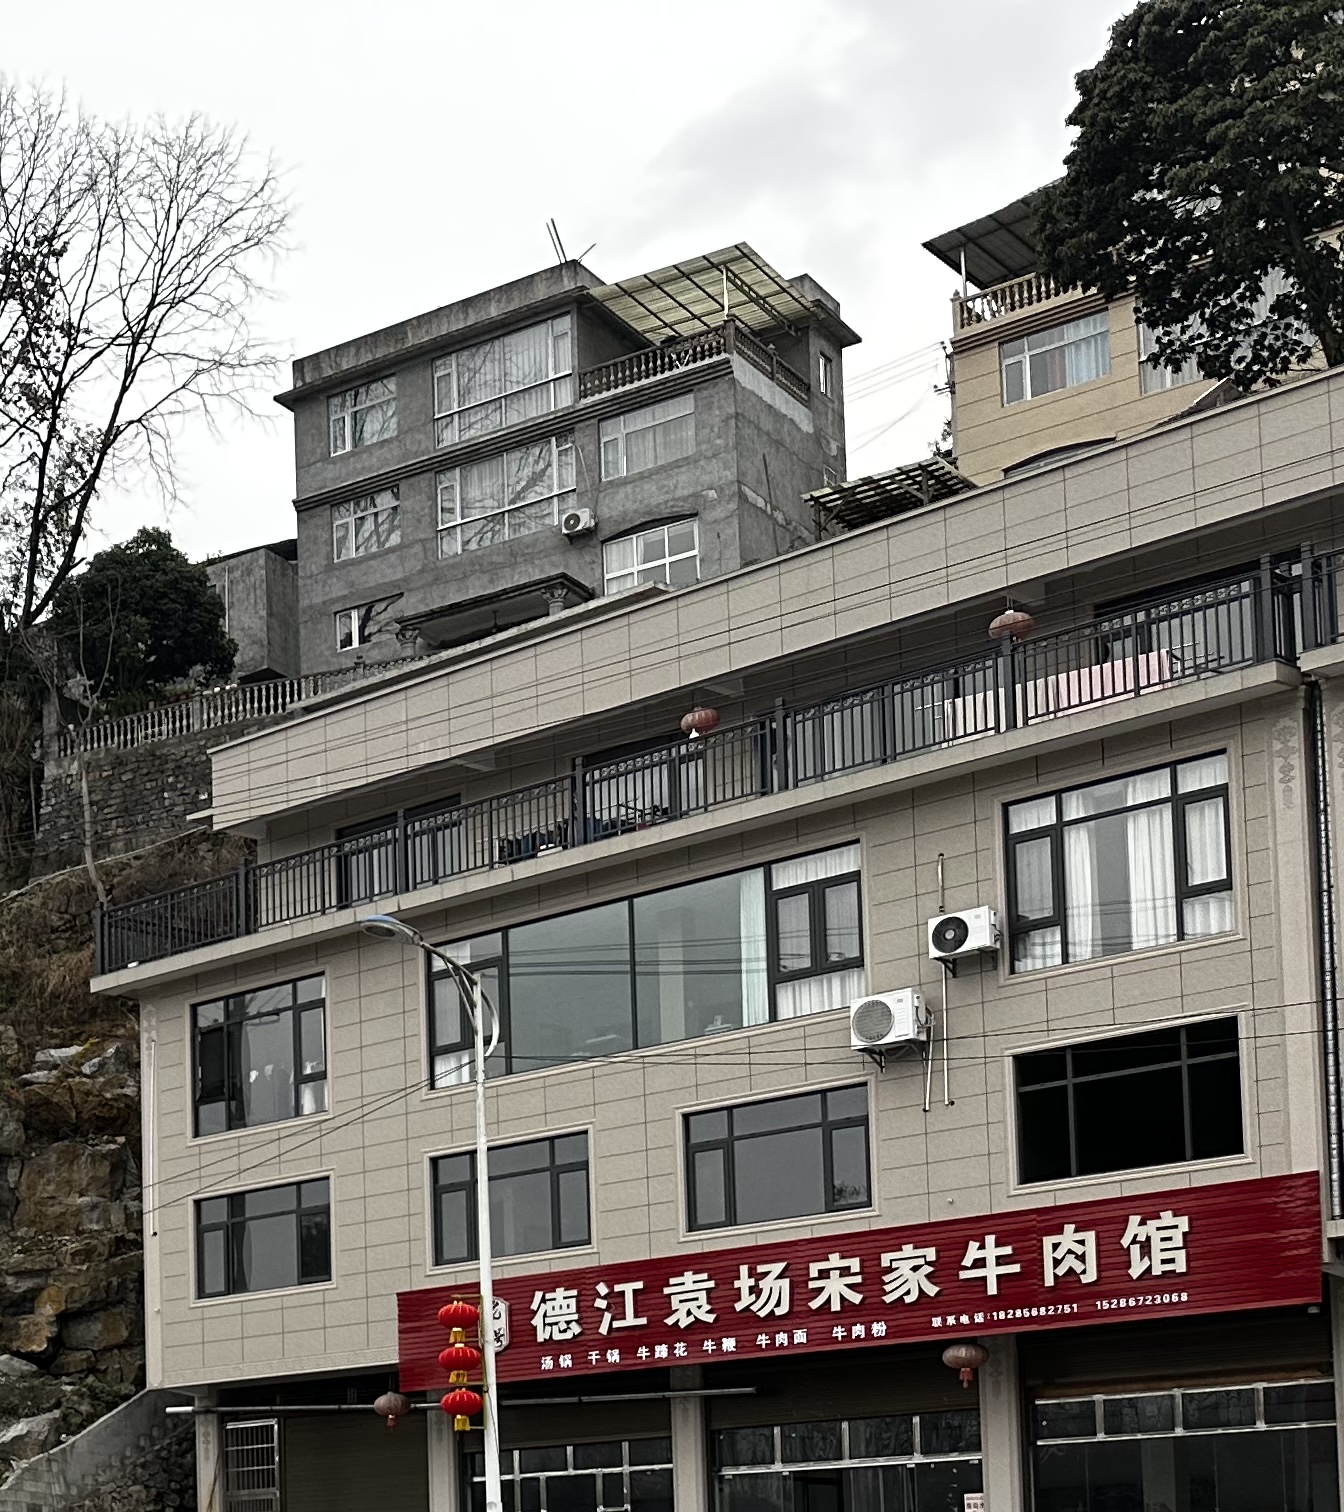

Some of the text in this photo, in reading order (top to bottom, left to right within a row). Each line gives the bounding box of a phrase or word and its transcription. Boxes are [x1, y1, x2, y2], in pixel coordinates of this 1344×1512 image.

[530, 1211, 1191, 1342] 德江袁场宋家牛肉馆
[541, 1353, 572, 1370] 汤锅
[756, 1329, 808, 1348] 牛肉面
[832, 1321, 887, 1341] 牛肉粉
